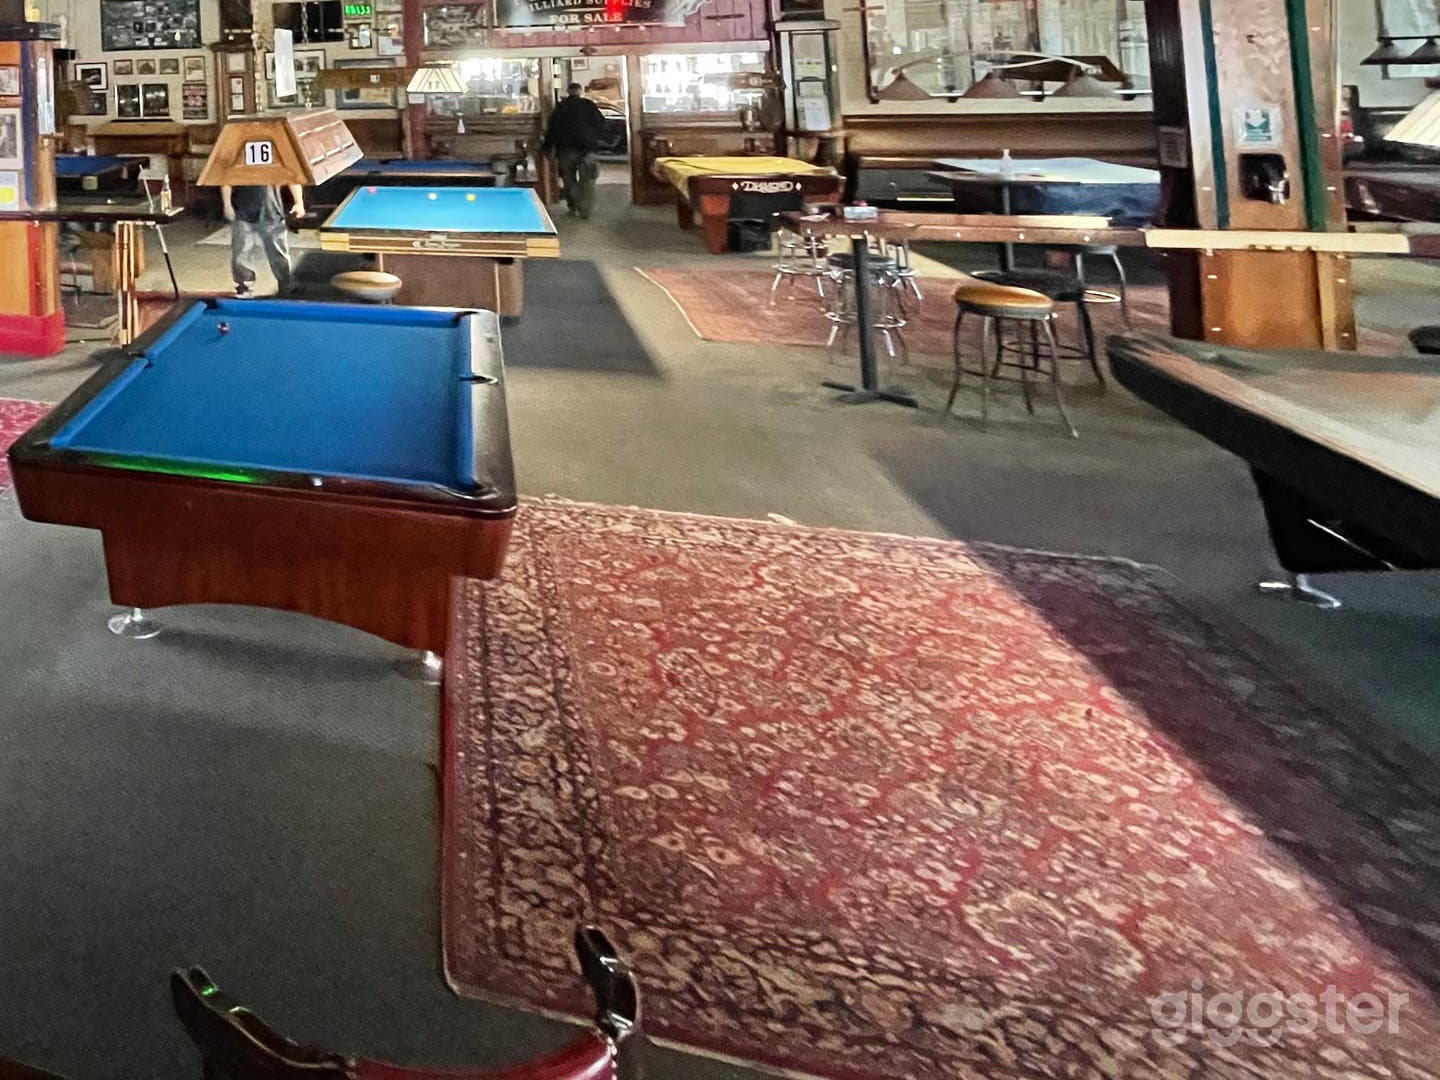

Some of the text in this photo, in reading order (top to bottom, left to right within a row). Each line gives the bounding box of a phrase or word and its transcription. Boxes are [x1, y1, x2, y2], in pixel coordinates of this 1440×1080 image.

[549, 11, 623, 25] FOR SALE
[249, 143, 270, 163] 16
